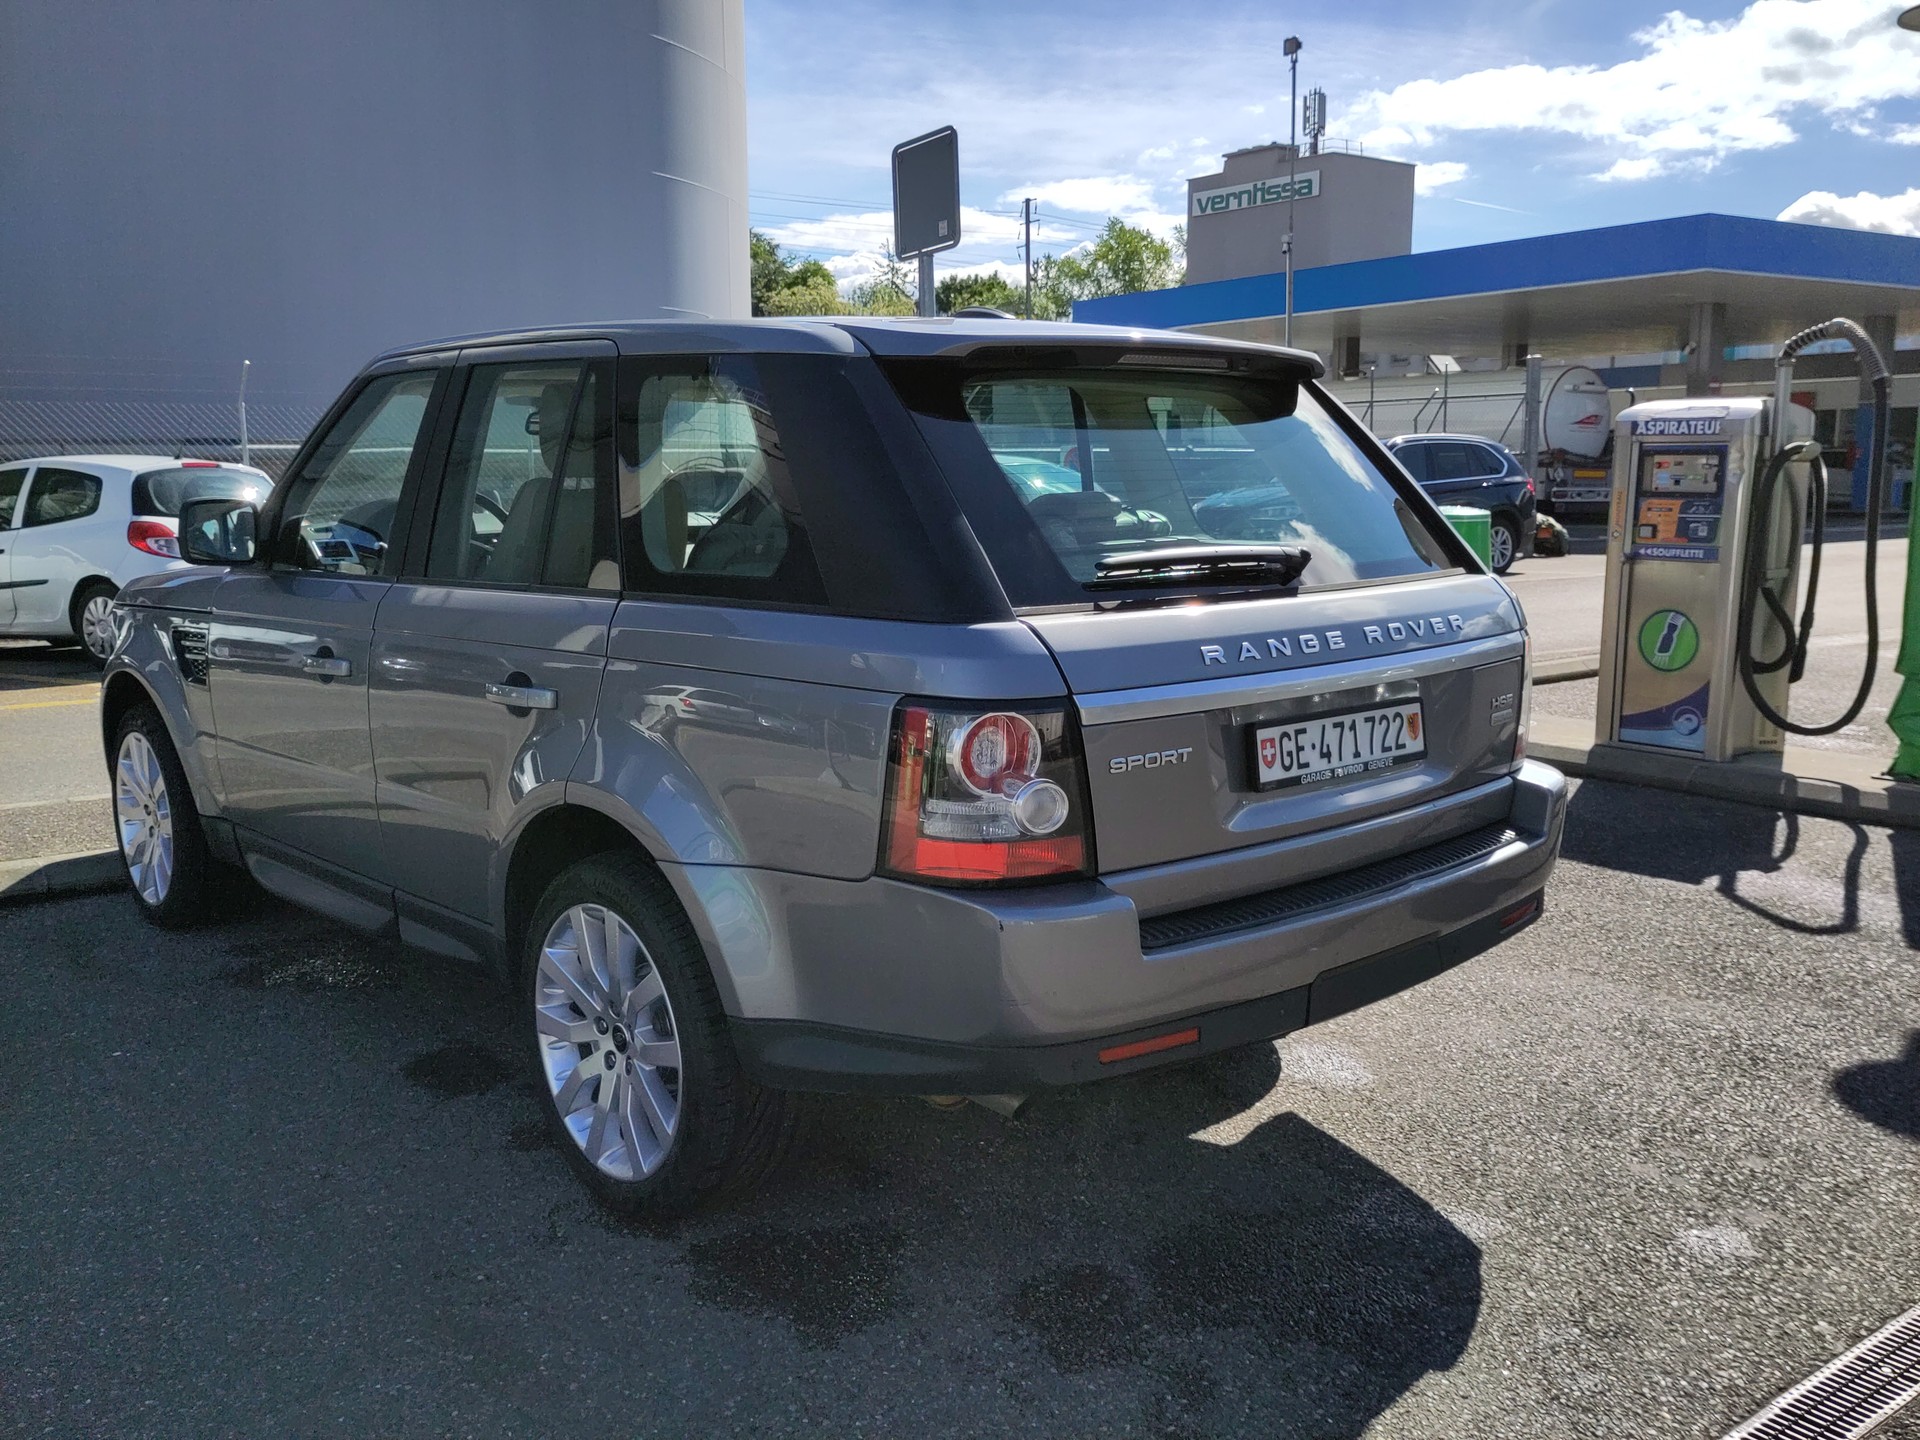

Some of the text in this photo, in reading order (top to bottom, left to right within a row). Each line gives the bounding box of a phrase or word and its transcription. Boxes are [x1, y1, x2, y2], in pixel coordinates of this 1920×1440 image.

[1196, 178, 1312, 214] verntissa
[1651, 547, 1704, 559] SOUFFLETTE
[1200, 614, 1465, 666] RANGE ROVER
[1109, 747, 1193, 775] SPORT
[1300, 769, 1332, 784] GARAGE
